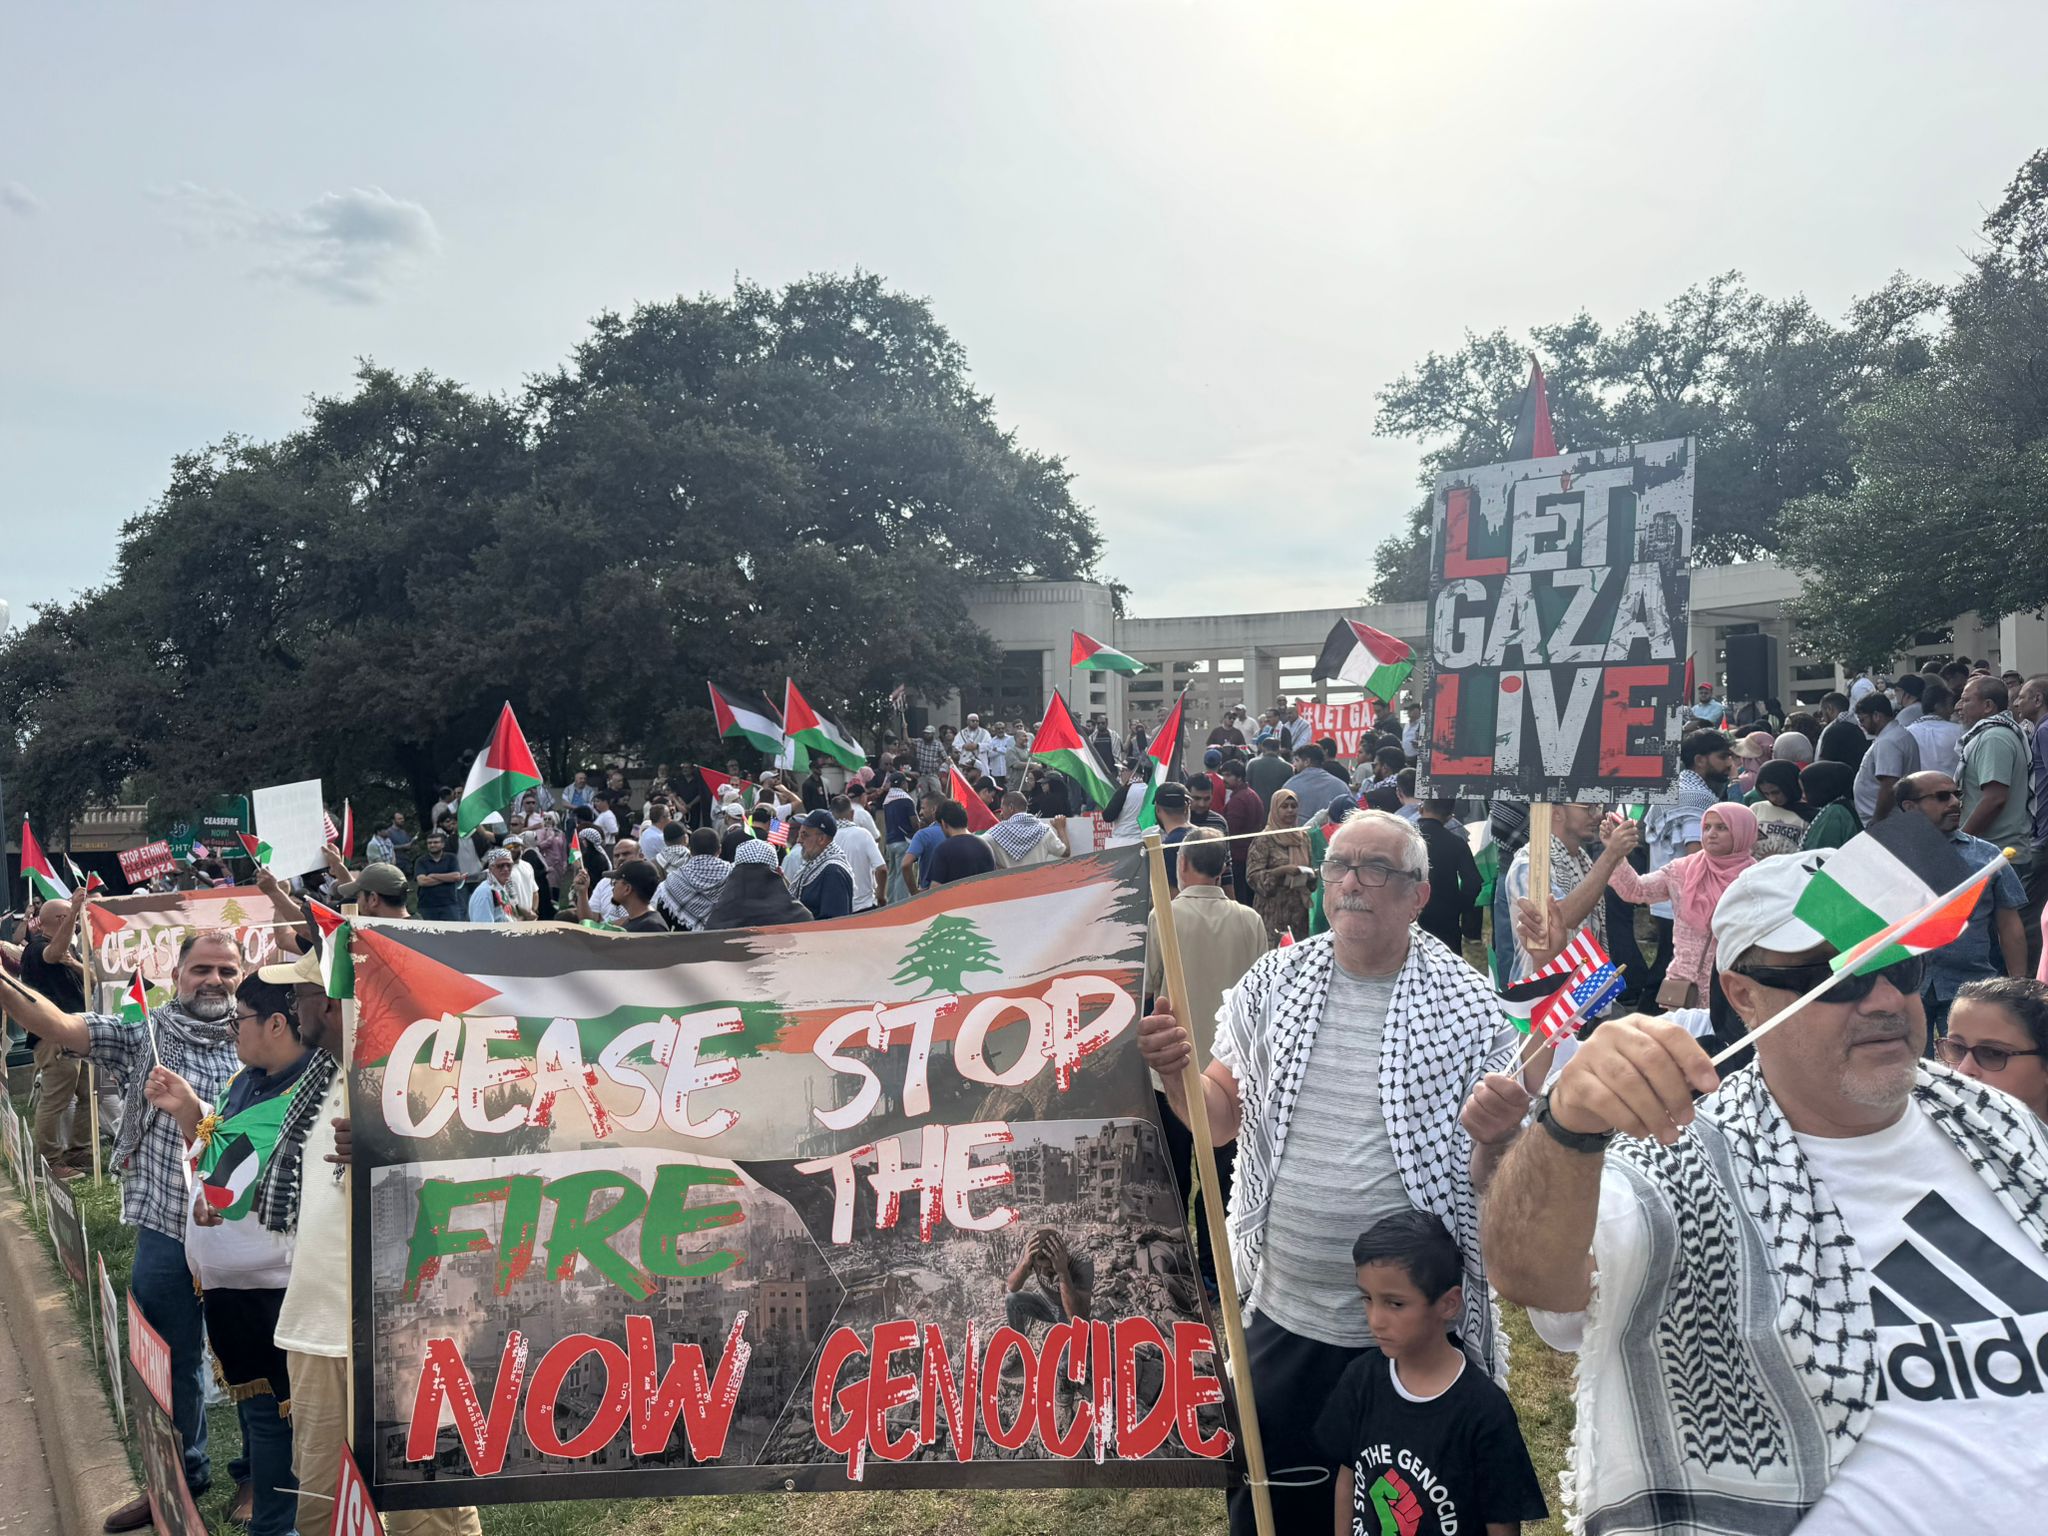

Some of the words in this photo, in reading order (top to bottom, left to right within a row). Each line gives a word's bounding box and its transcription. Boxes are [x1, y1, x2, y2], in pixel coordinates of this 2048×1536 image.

[1443, 467, 1635, 580] LET
[1433, 561, 1677, 670] GAZA
[1302, 704, 1345, 730] #LET
[1350, 700, 1377, 729] GA
[120, 850, 139, 865] STOP
[140, 842, 169, 859] ETHNIC
[124, 853, 171, 873] CLEANSING
[129, 872, 141, 883] IN
[144, 862, 174, 877] GAZA
[203, 817, 239, 826] CEASEFIRE
[382, 1006, 746, 1140] CEASE
[811, 974, 1138, 1130] STOP
[402, 1163, 748, 1302] FIRE
[795, 1121, 1020, 1246] THE
[405, 1310, 751, 1478] NOW
[811, 1316, 1236, 1482] GENOCIDE
[1875, 1316, 2048, 1402] did
[1353, 1460, 1366, 1513] STOP
[1360, 1443, 1393, 1468] THE
[1397, 1448, 1458, 1536] GENOCID
